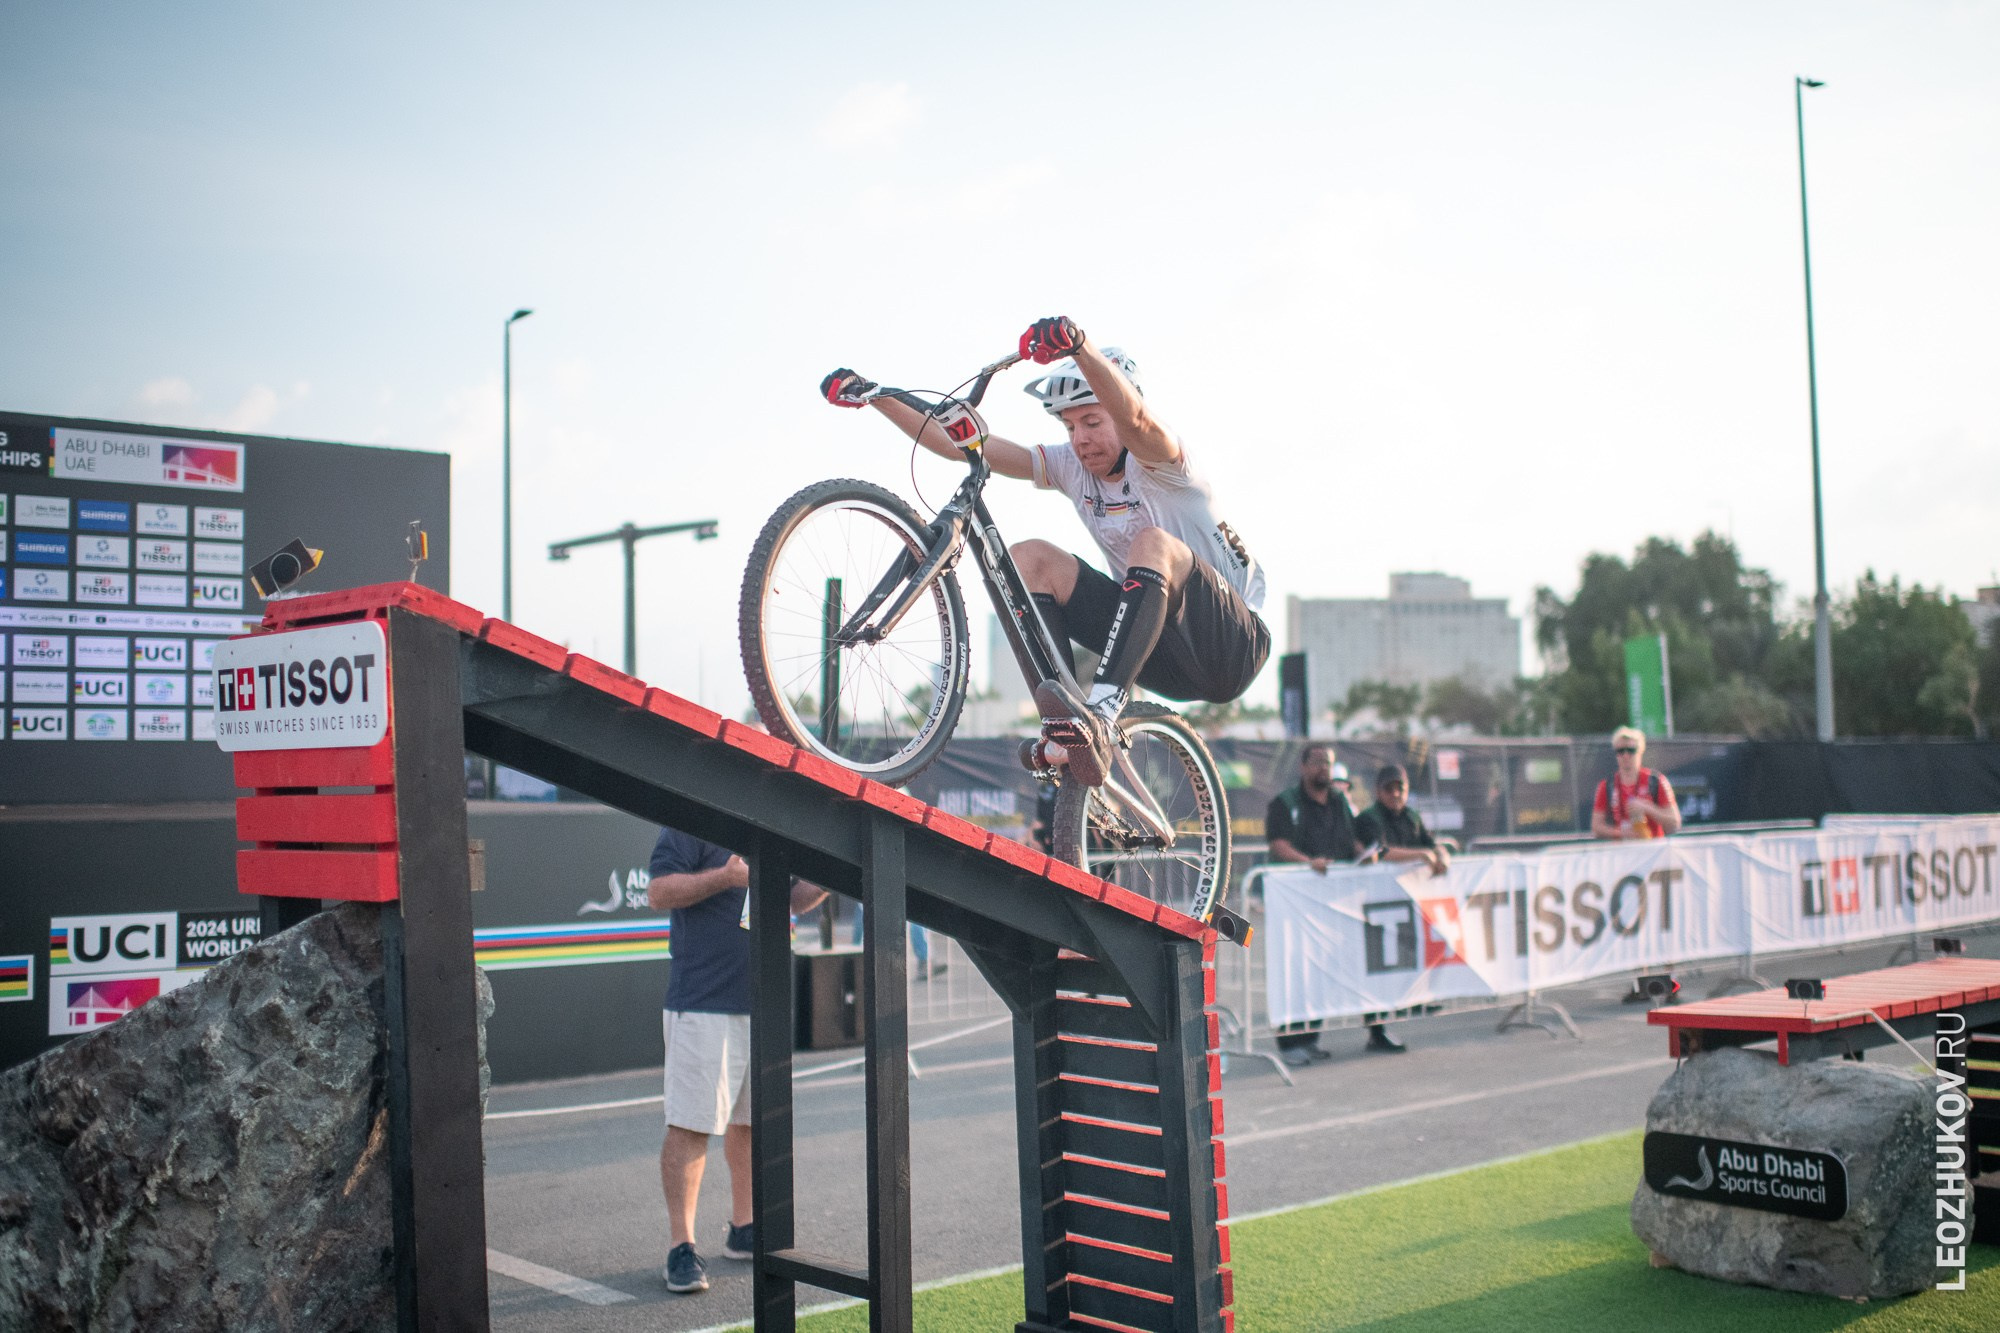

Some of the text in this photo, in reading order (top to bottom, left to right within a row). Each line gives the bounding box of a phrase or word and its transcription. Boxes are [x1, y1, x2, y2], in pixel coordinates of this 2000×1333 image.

[65, 438, 150, 459] ABU DHABI
[0, 450, 41, 467] HIPS
[65, 457, 96, 472] UAE
[80, 510, 127, 521] SHIMANO
[200, 522, 239, 531] TISSOT
[18, 543, 66, 554] SHIMANO
[142, 552, 182, 563] TISSOT
[82, 585, 125, 595] TISSOT
[203, 586, 239, 601] UCI
[1096, 601, 1128, 676] hebo
[19, 649, 63, 658] TISSOT
[144, 647, 182, 661] UCI
[84, 681, 123, 695] UCI
[258, 654, 375, 709] TISSOT
[22, 717, 62, 731] UCI
[140, 724, 180, 733] TISSOT
[219, 713, 378, 736] SWISS WATCHES SINCE 1853
[1864, 845, 1997, 910] TISSOT
[1465, 868, 1683, 962] TISSOT
[186, 920, 228, 937] 2024
[73, 923, 166, 963] UCI
[186, 939, 254, 958] WORLD
[1718, 1149, 1824, 1181] Abu Dhabi
[1718, 1172, 1826, 1204] Sports Council
